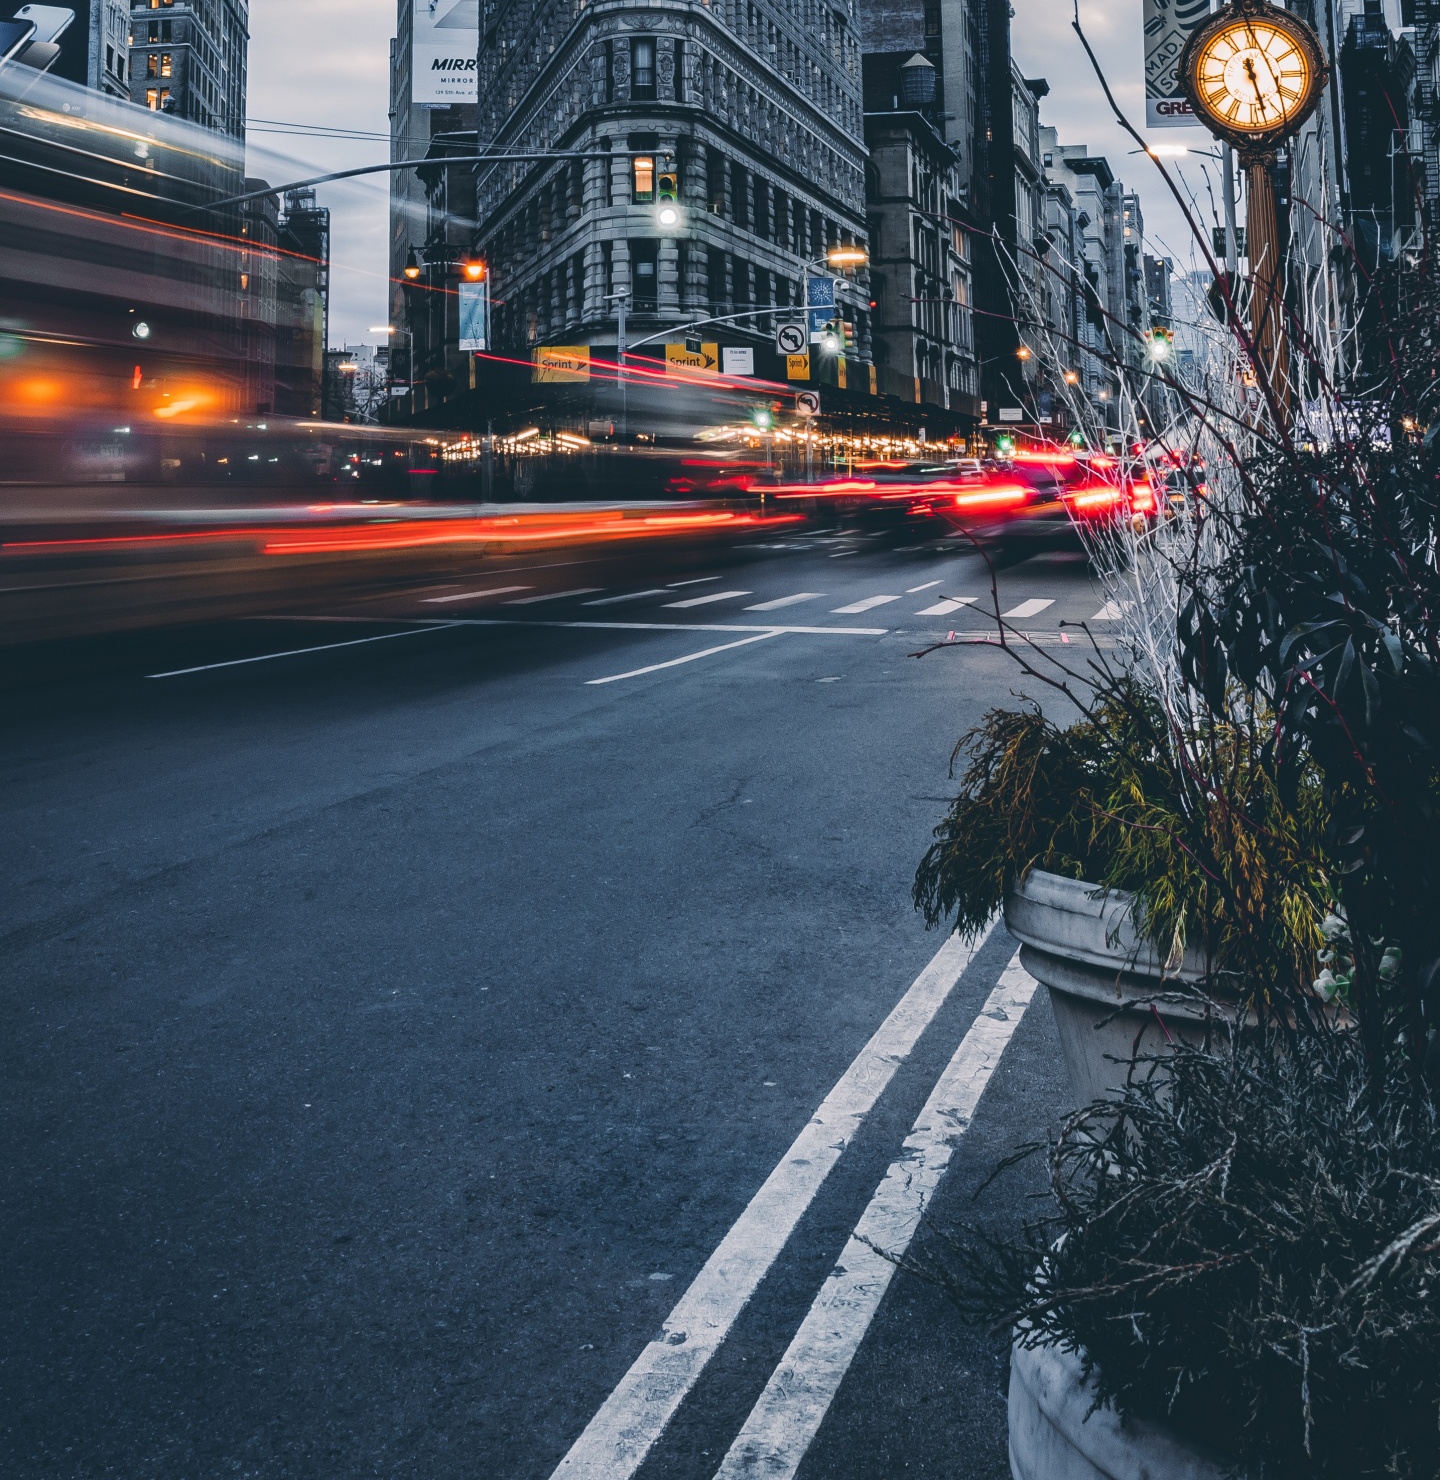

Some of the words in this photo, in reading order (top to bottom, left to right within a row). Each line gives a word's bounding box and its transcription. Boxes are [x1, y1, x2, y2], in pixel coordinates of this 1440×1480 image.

[431, 58, 478, 70] MIRR
[541, 360, 572, 372] Sprint
[670, 357, 700, 369] Sprint
[788, 358, 802, 370] Sprint
